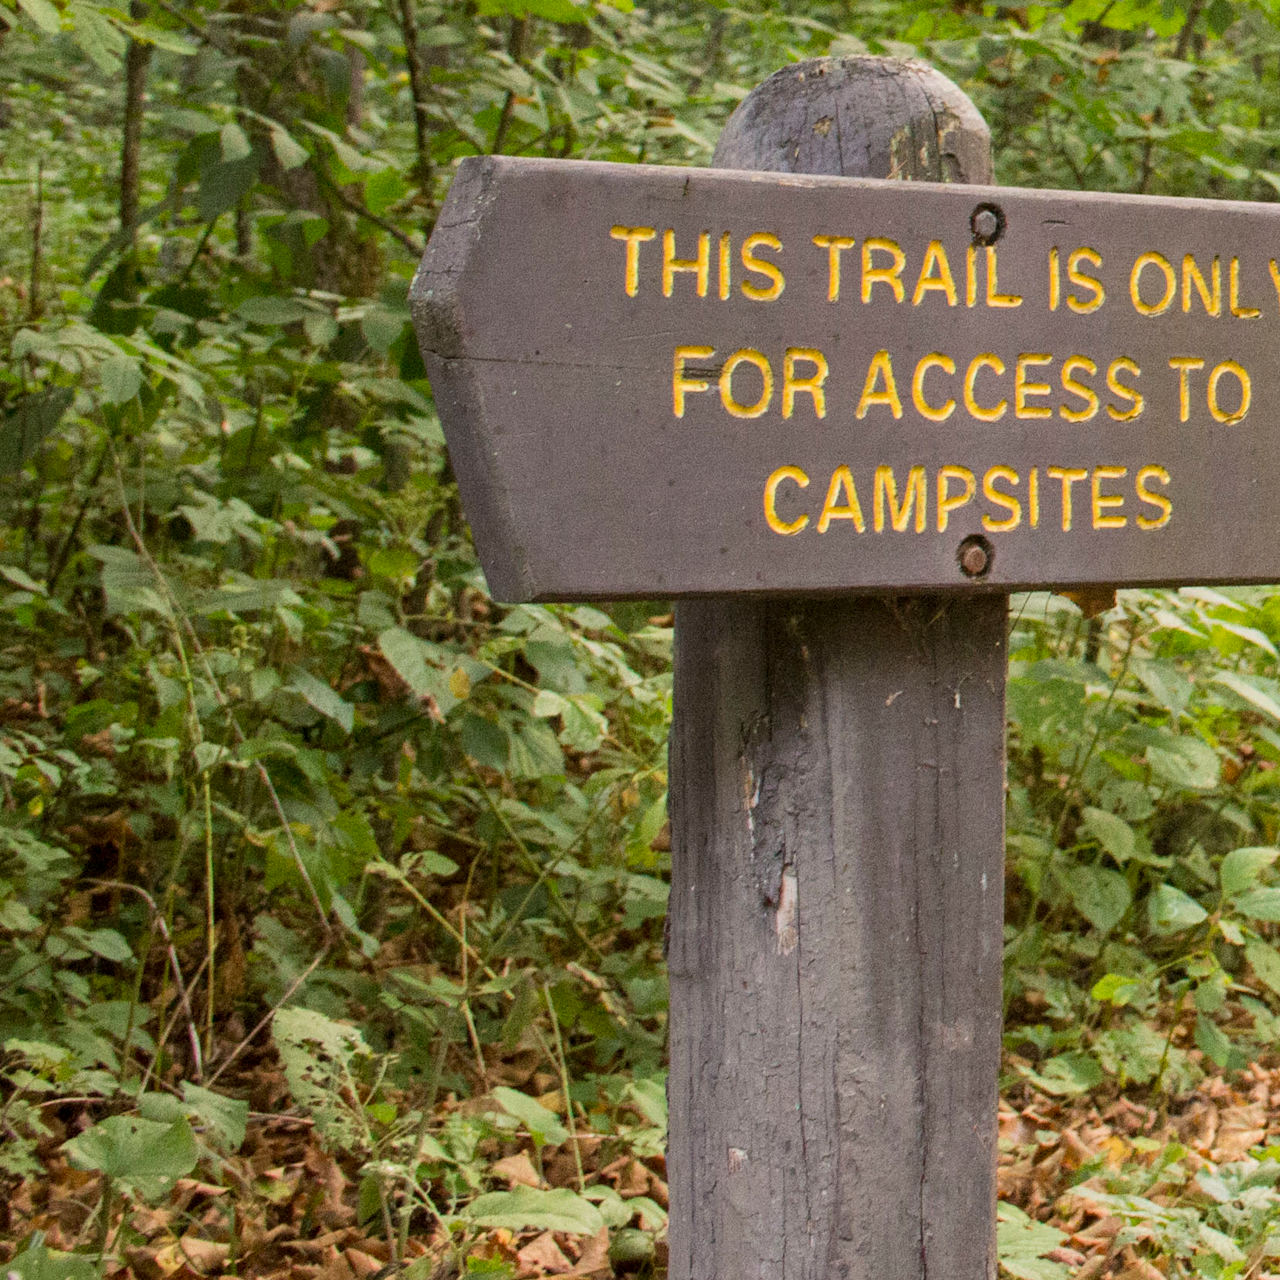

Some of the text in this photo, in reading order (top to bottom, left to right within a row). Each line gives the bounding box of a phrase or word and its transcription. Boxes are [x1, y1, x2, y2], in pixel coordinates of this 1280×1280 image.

[609, 223, 786, 302] THIS
[811, 234, 1024, 309] TRAIL
[1048, 245, 1106, 315] IS
[671, 344, 1253, 427] FOR ACCESS TO
[763, 463, 1173, 537] CAMPSITES
